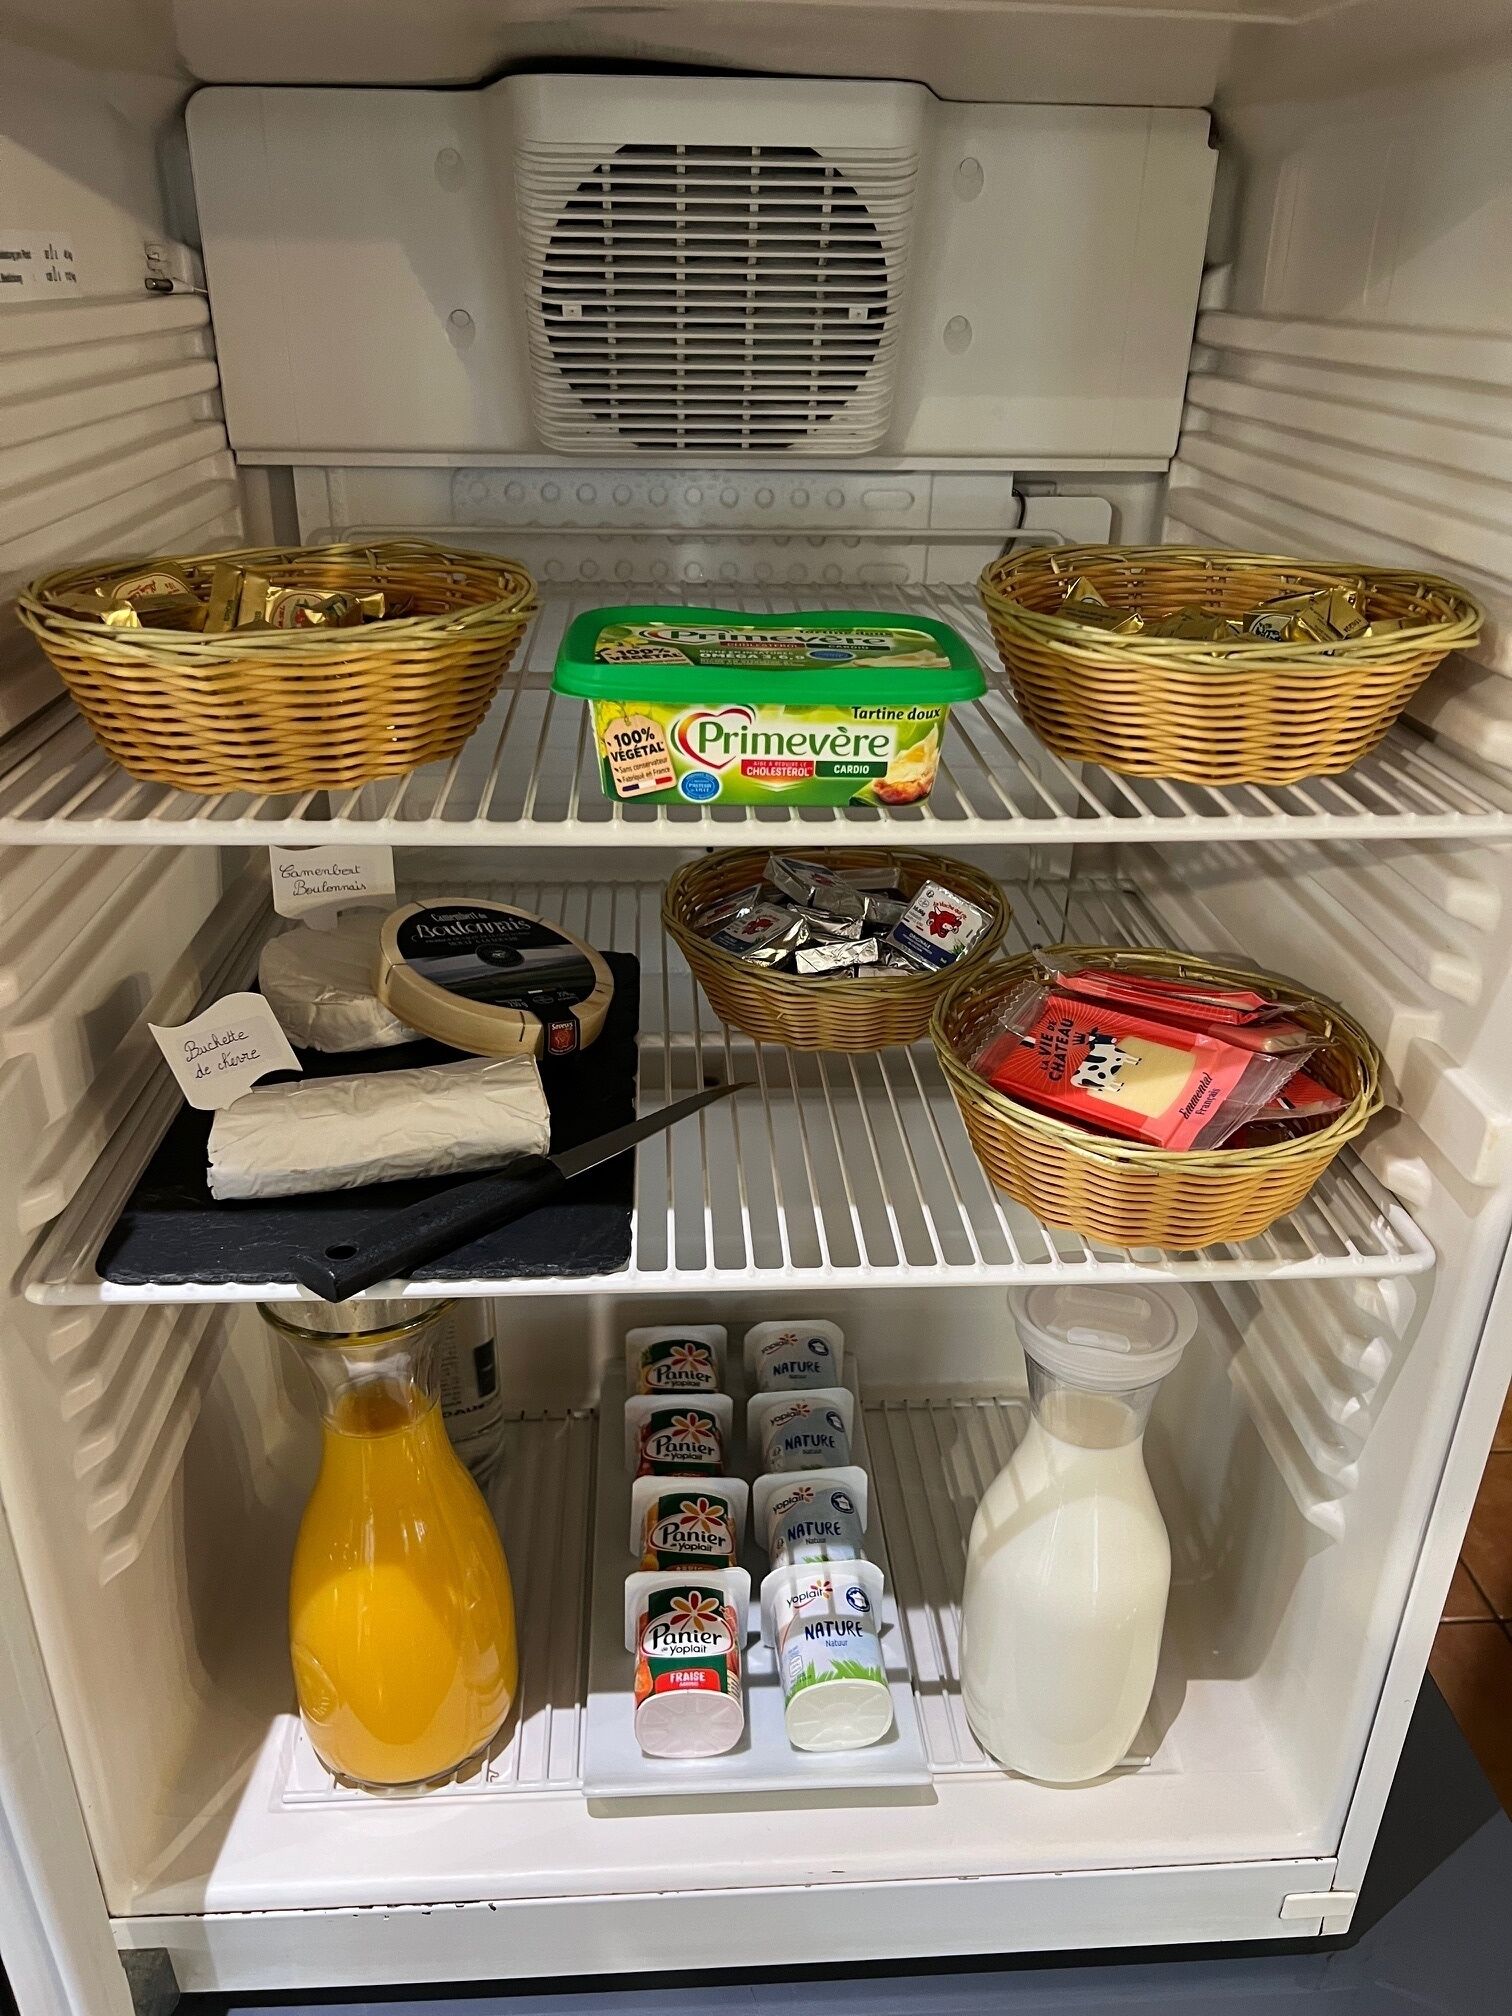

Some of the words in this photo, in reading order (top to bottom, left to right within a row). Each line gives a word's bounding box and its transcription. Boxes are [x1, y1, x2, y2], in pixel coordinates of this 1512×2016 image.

[852, 706, 904, 720] Tartine
[907, 707, 941, 720] doux
[613, 727, 655, 746] 100%
[699, 721, 889, 757] Primevère
[833, 764, 870, 775] CARDIO
[293, 879, 367, 896] Boulonnais
[1047, 1020, 1056, 1031] DE
[184, 1030, 249, 1062] Buchette
[1040, 1033, 1054, 1055] VIE
[195, 1063, 211, 1079] de
[1040, 1060, 1049, 1070] LA
[1179, 1072, 1213, 1119] Emmental
[1195, 1088, 1220, 1115] Français
[653, 1365, 712, 1383] Panier
[773, 1361, 822, 1376] NATURE
[652, 1435, 715, 1455] Panier
[785, 1434, 836, 1450] NATURE
[658, 1522, 725, 1547] Panier
[787, 1521, 841, 1541] NATURE
[786, 1588, 823, 1609] yoplait
[648, 1622, 722, 1650] Panier
[804, 1620, 864, 1641] NATURE
[825, 1640, 848, 1648] Natuur
[670, 1671, 706, 1683] FRAISE
